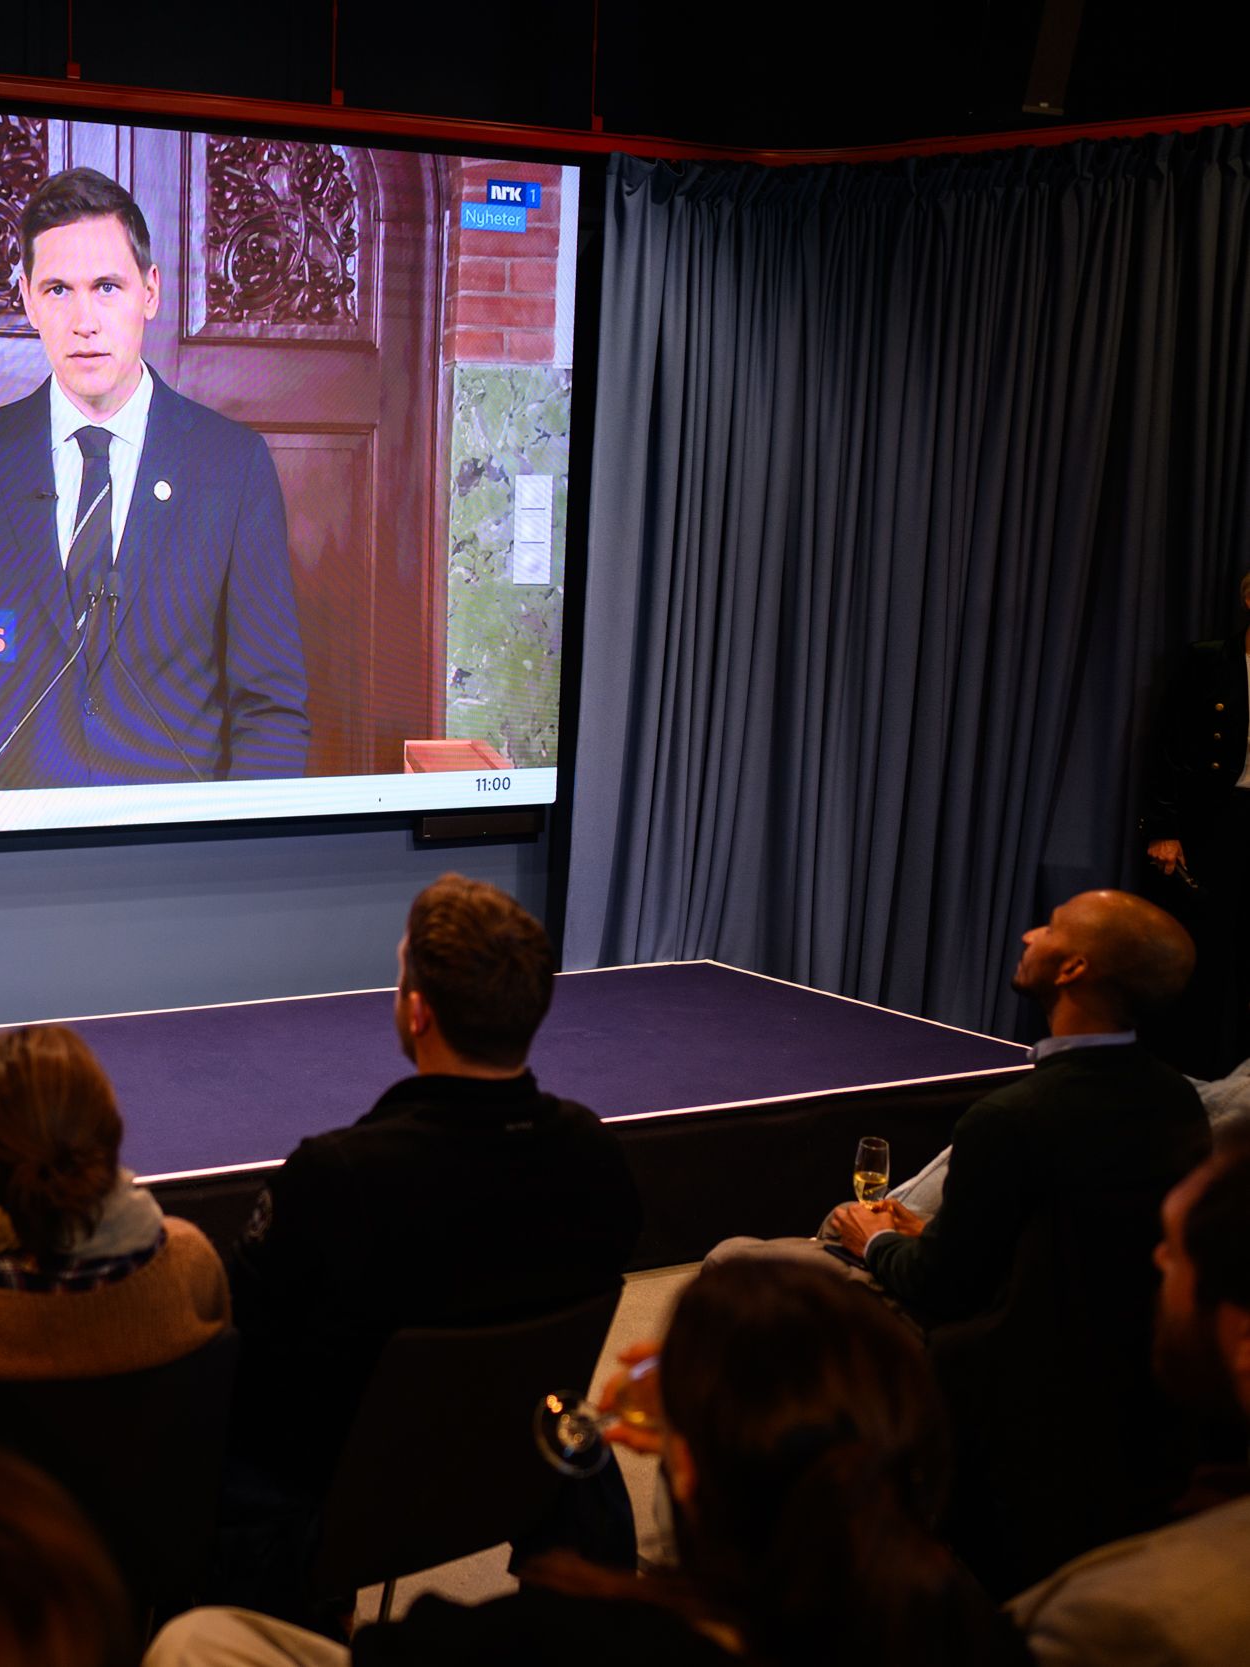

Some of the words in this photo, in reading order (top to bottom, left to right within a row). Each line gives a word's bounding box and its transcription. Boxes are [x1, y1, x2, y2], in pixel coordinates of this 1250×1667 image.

[491, 185, 522, 202] NRK
[529, 189, 536, 203] 1
[465, 208, 521, 227] Nyheter
[475, 776, 511, 791] 11:00
